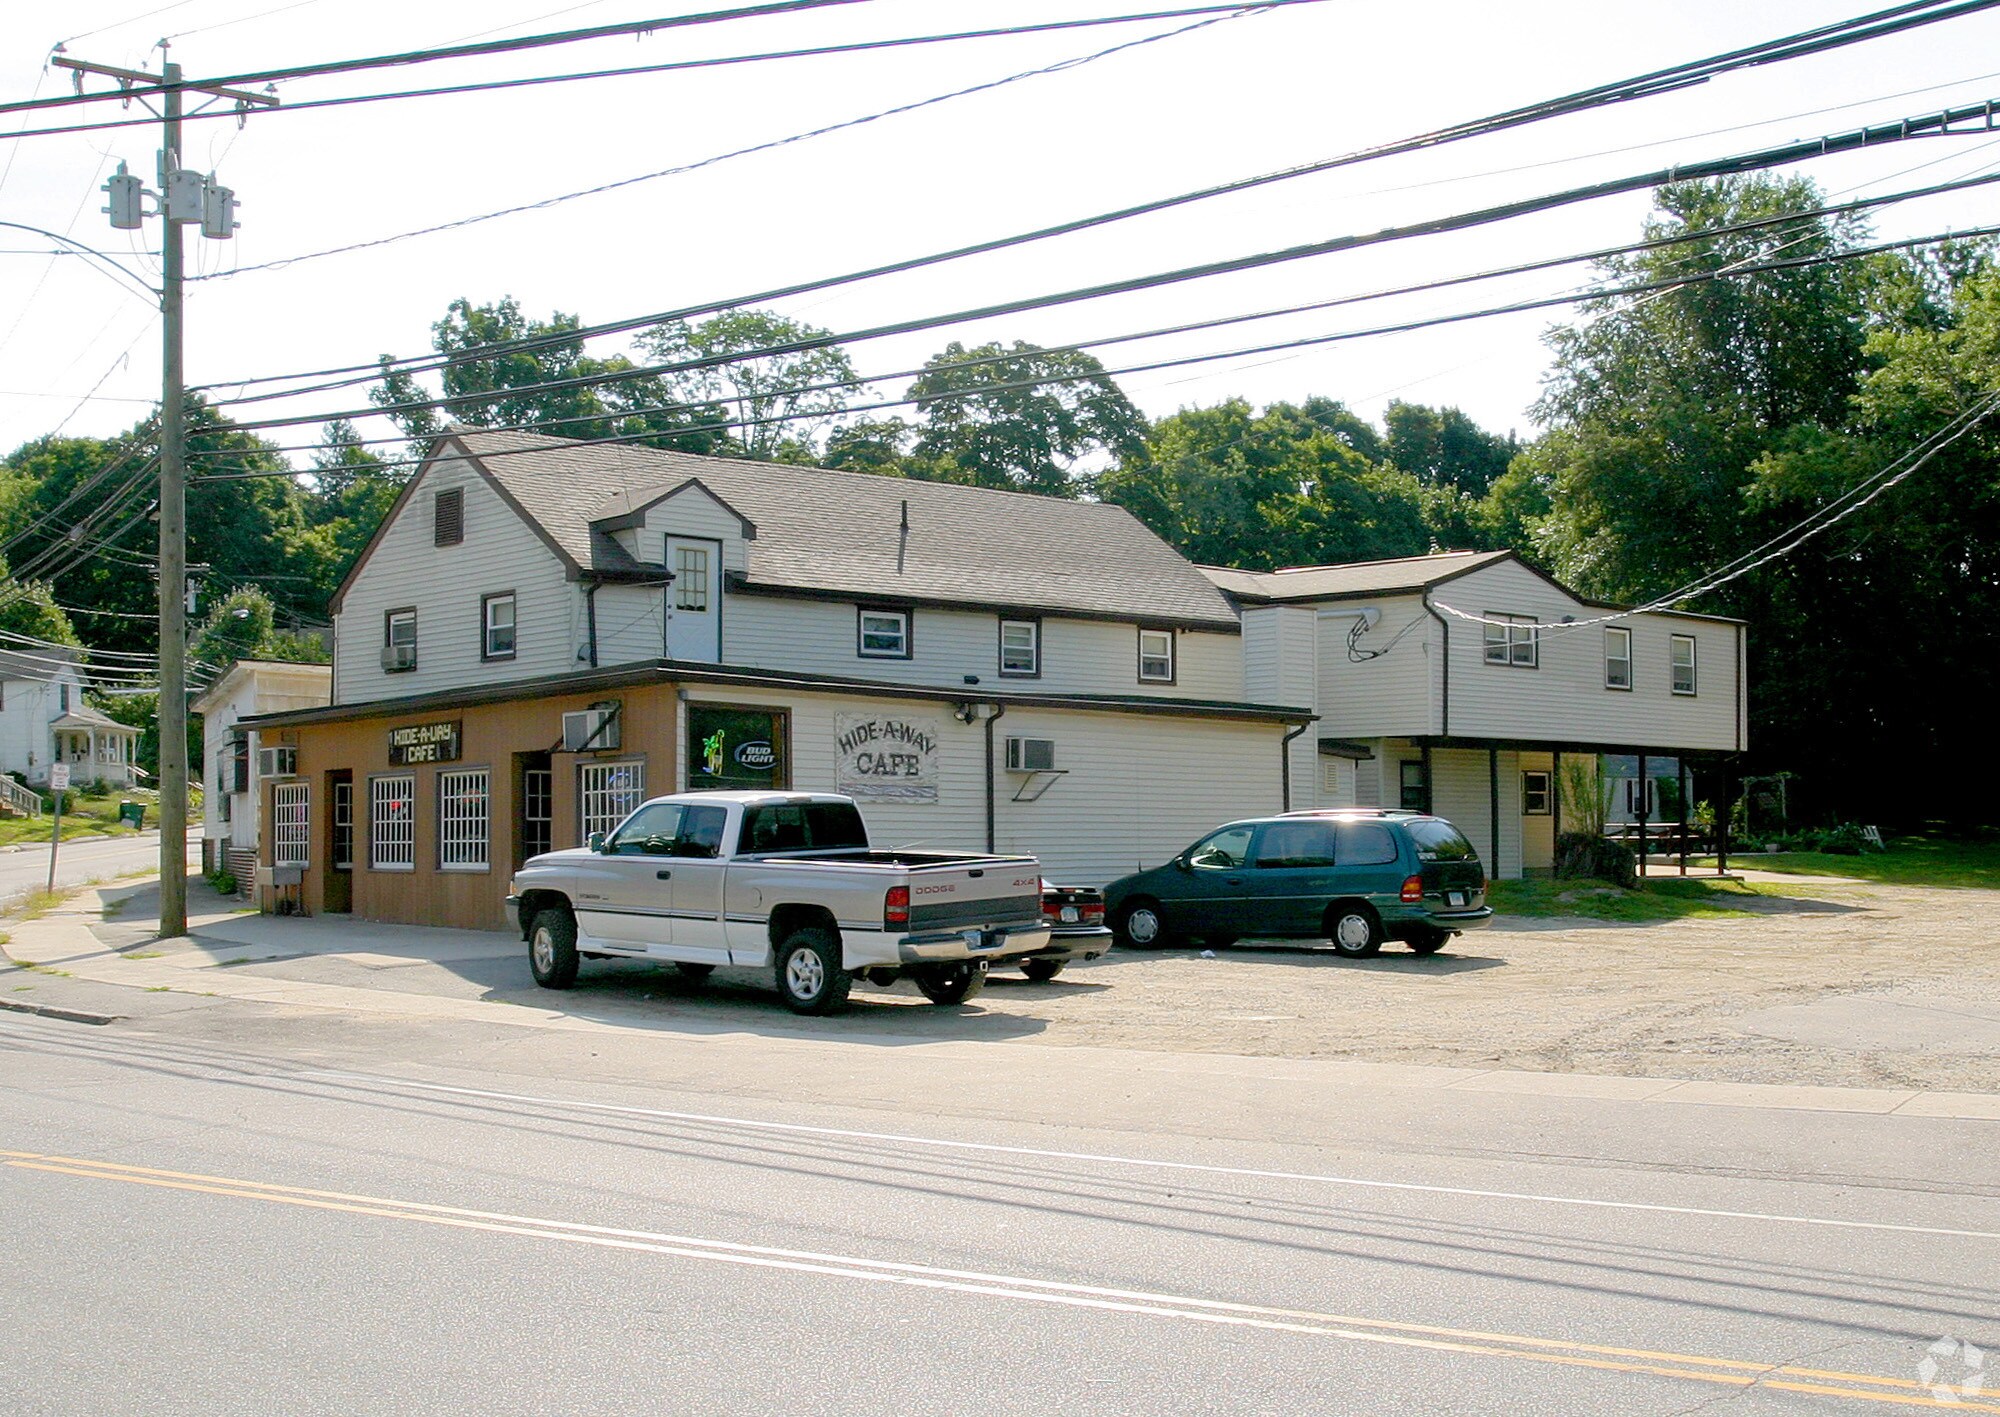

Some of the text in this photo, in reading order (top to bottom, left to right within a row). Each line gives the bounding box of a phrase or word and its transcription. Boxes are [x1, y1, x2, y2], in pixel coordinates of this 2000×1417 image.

[838, 720, 936, 755] HIDE-A-WAY
[408, 744, 436, 763] CAFE
[746, 746, 772, 755] BUD
[741, 754, 775, 763] LIGHT
[857, 753, 919, 776] CAFE
[915, 884, 956, 895] DODGE
